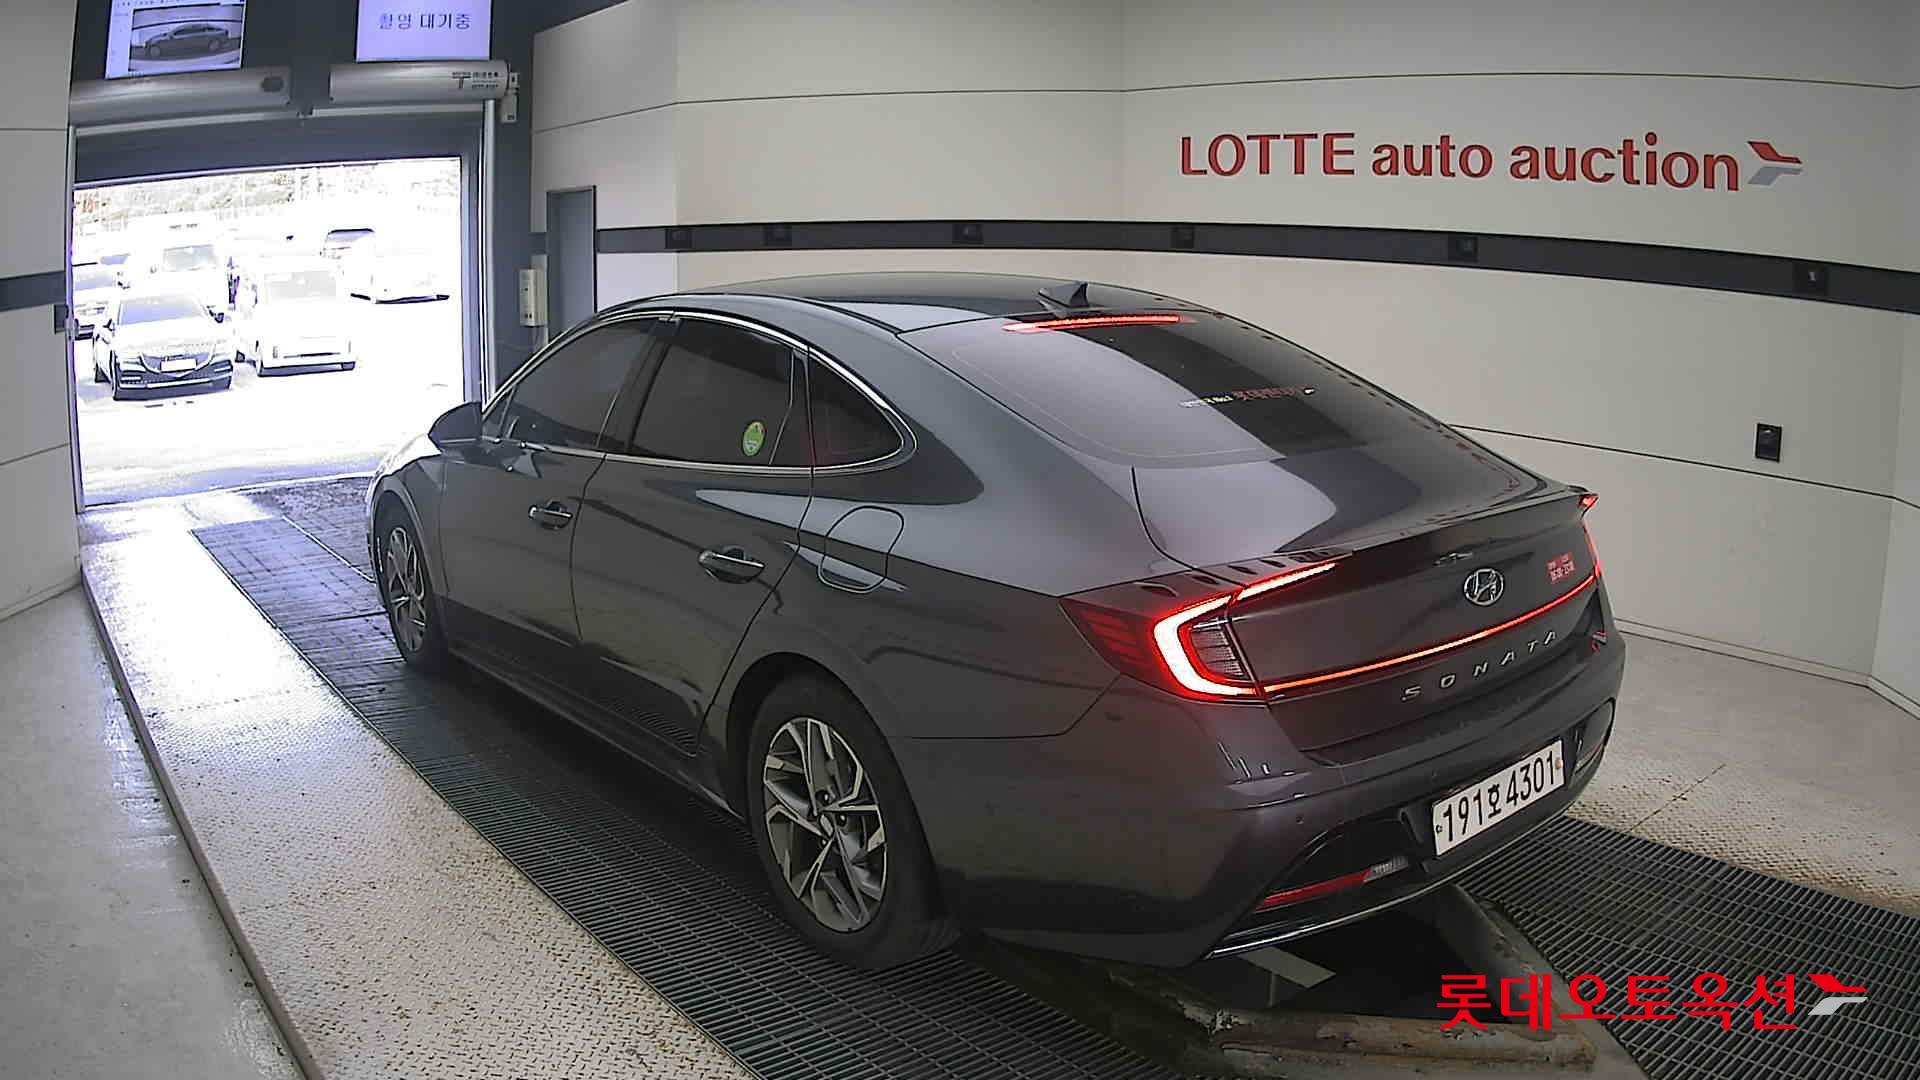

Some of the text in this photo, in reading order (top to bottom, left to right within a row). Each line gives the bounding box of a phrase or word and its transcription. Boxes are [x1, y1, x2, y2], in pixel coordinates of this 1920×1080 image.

[420, 13, 472, 30] 대기중
[1181, 131, 1739, 192] LOTTE auto auction
[1401, 630, 1557, 702] SONATA
